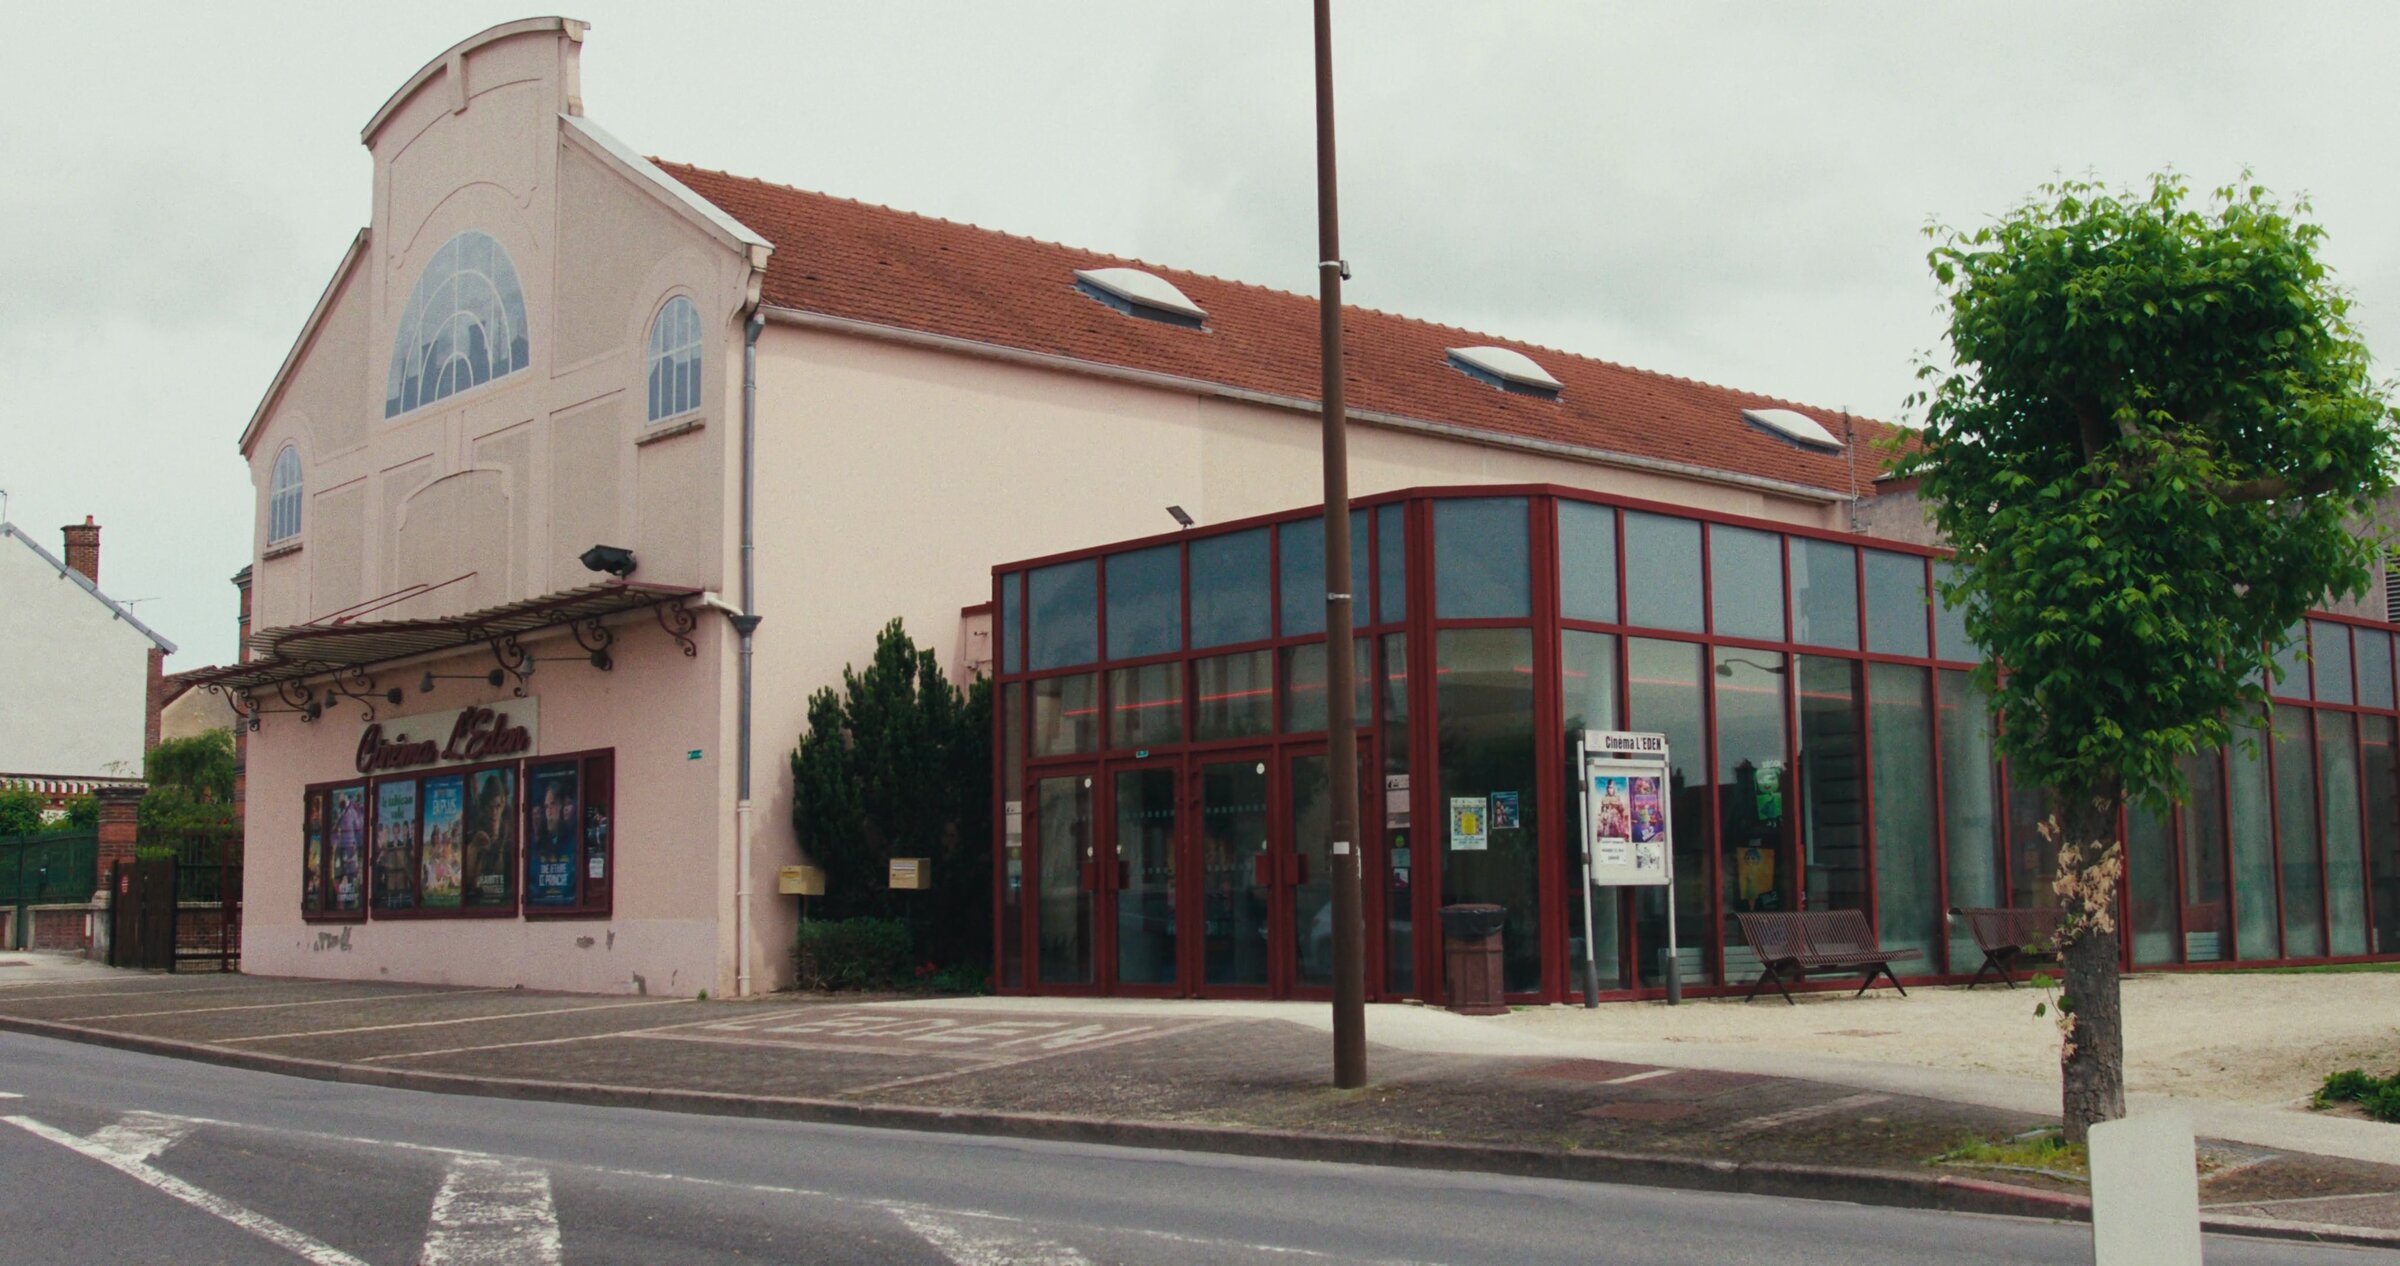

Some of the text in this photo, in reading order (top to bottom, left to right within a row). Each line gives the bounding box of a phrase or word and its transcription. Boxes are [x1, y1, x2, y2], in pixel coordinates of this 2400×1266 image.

[356, 706, 532, 773] Cinéma L'Eden
[1605, 735, 1662, 751] Cinéma L'EDEN
